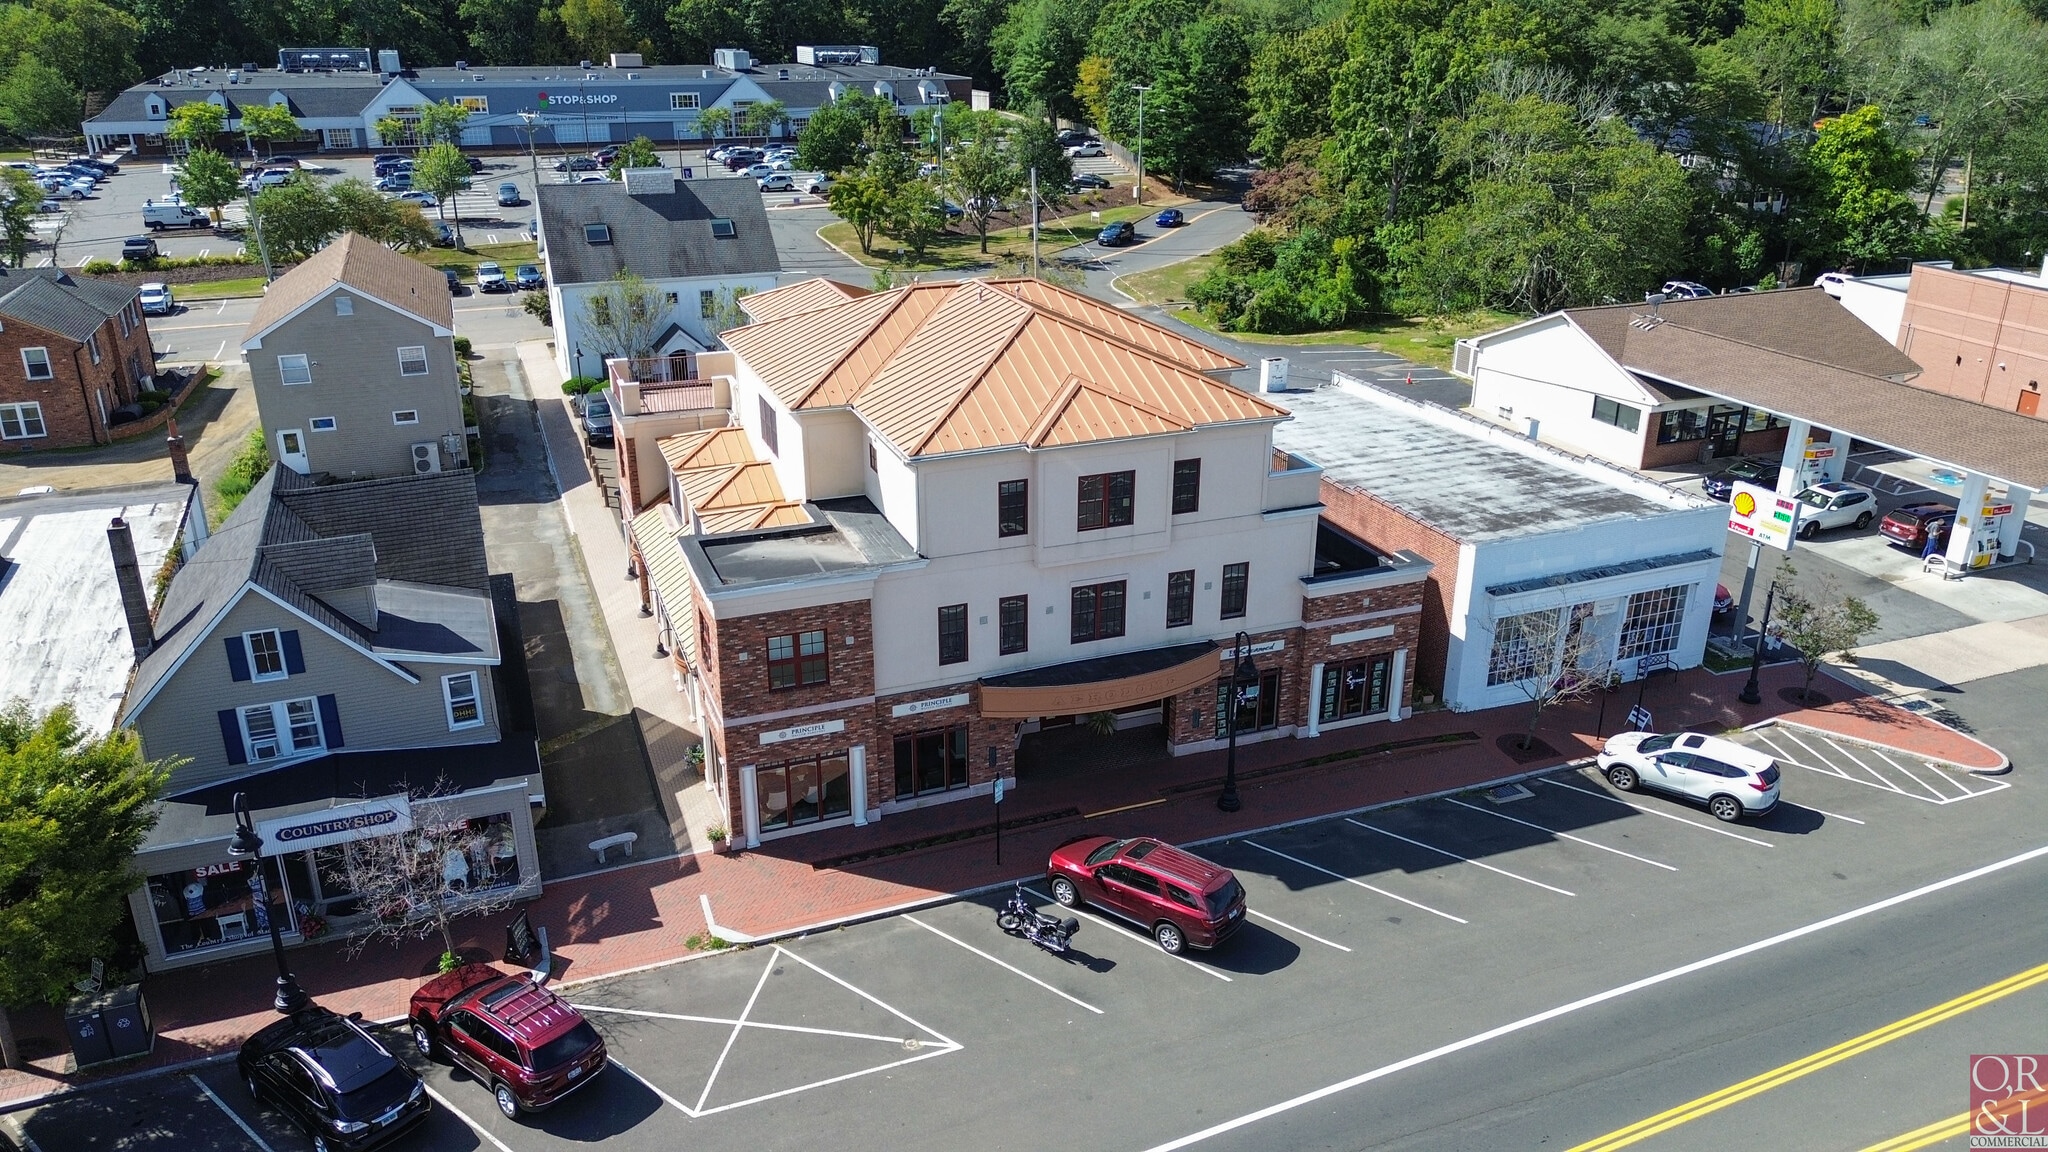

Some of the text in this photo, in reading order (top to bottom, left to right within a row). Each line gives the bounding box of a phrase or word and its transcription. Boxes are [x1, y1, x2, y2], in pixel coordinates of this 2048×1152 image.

[1759, 532, 1771, 541] ATM
[921, 697, 952, 708] PRINCIPLE
[791, 724, 825, 735] PRINCIPLE
[280, 811, 394, 840] COUNTRY SHOP
[426, 819, 468, 837] SALE
[195, 861, 240, 877] SALE
[196, 937, 224, 948] Country
